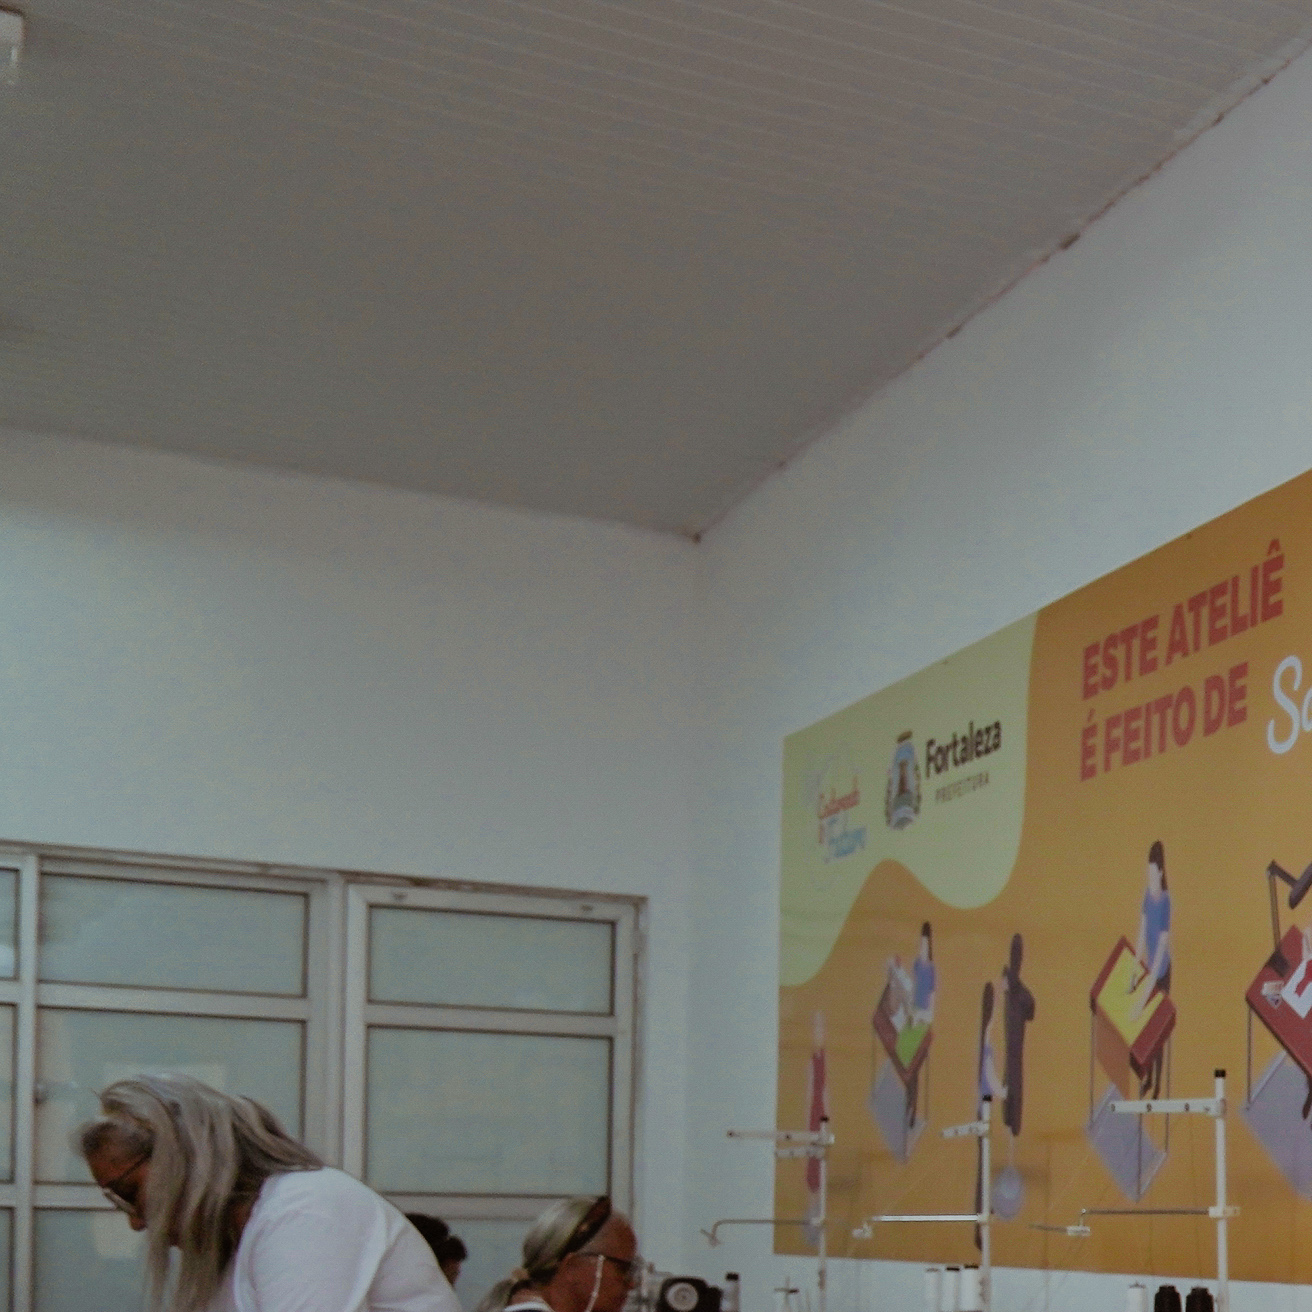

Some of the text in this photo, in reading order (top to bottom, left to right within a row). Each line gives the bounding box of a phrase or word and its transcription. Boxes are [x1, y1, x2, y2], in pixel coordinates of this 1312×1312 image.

[1082, 538, 1285, 699] ESTE ATELIÊ
[925, 720, 1002, 779] Fortaleza
[1080, 707, 1098, 782] É
[1103, 685, 1196, 773] FEITO
[1202, 661, 1249, 738] DE
[935, 771, 990, 804] PREFEITURA
